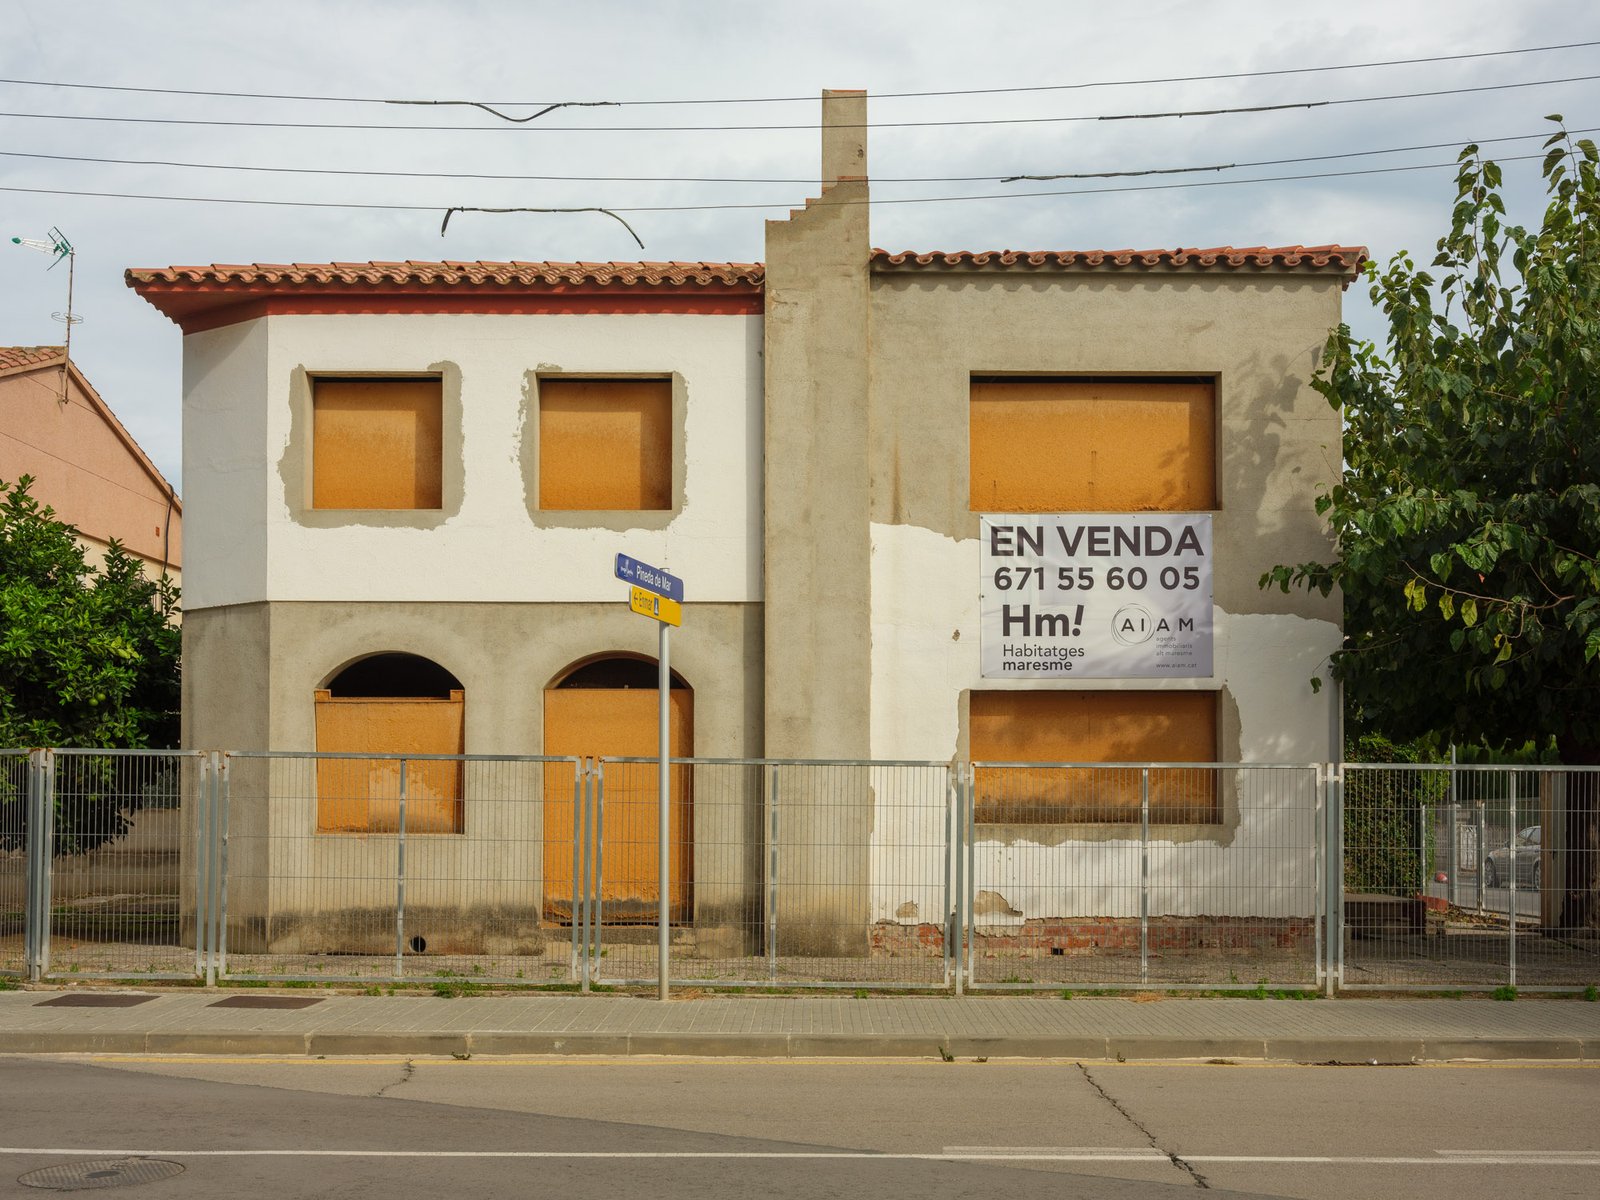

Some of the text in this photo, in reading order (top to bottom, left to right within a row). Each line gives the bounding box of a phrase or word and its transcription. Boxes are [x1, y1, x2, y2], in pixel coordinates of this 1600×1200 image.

[991, 525, 1205, 557] EN VENDA
[636, 565, 654, 584] Pineda
[654, 573, 661, 588] de
[661, 576, 672, 592] Mar
[994, 566, 1200, 591] 671 55 60 05
[1002, 604, 1085, 637] Hm!
[1003, 643, 1085, 661] Habitatges
[1003, 660, 1073, 671] maresme
